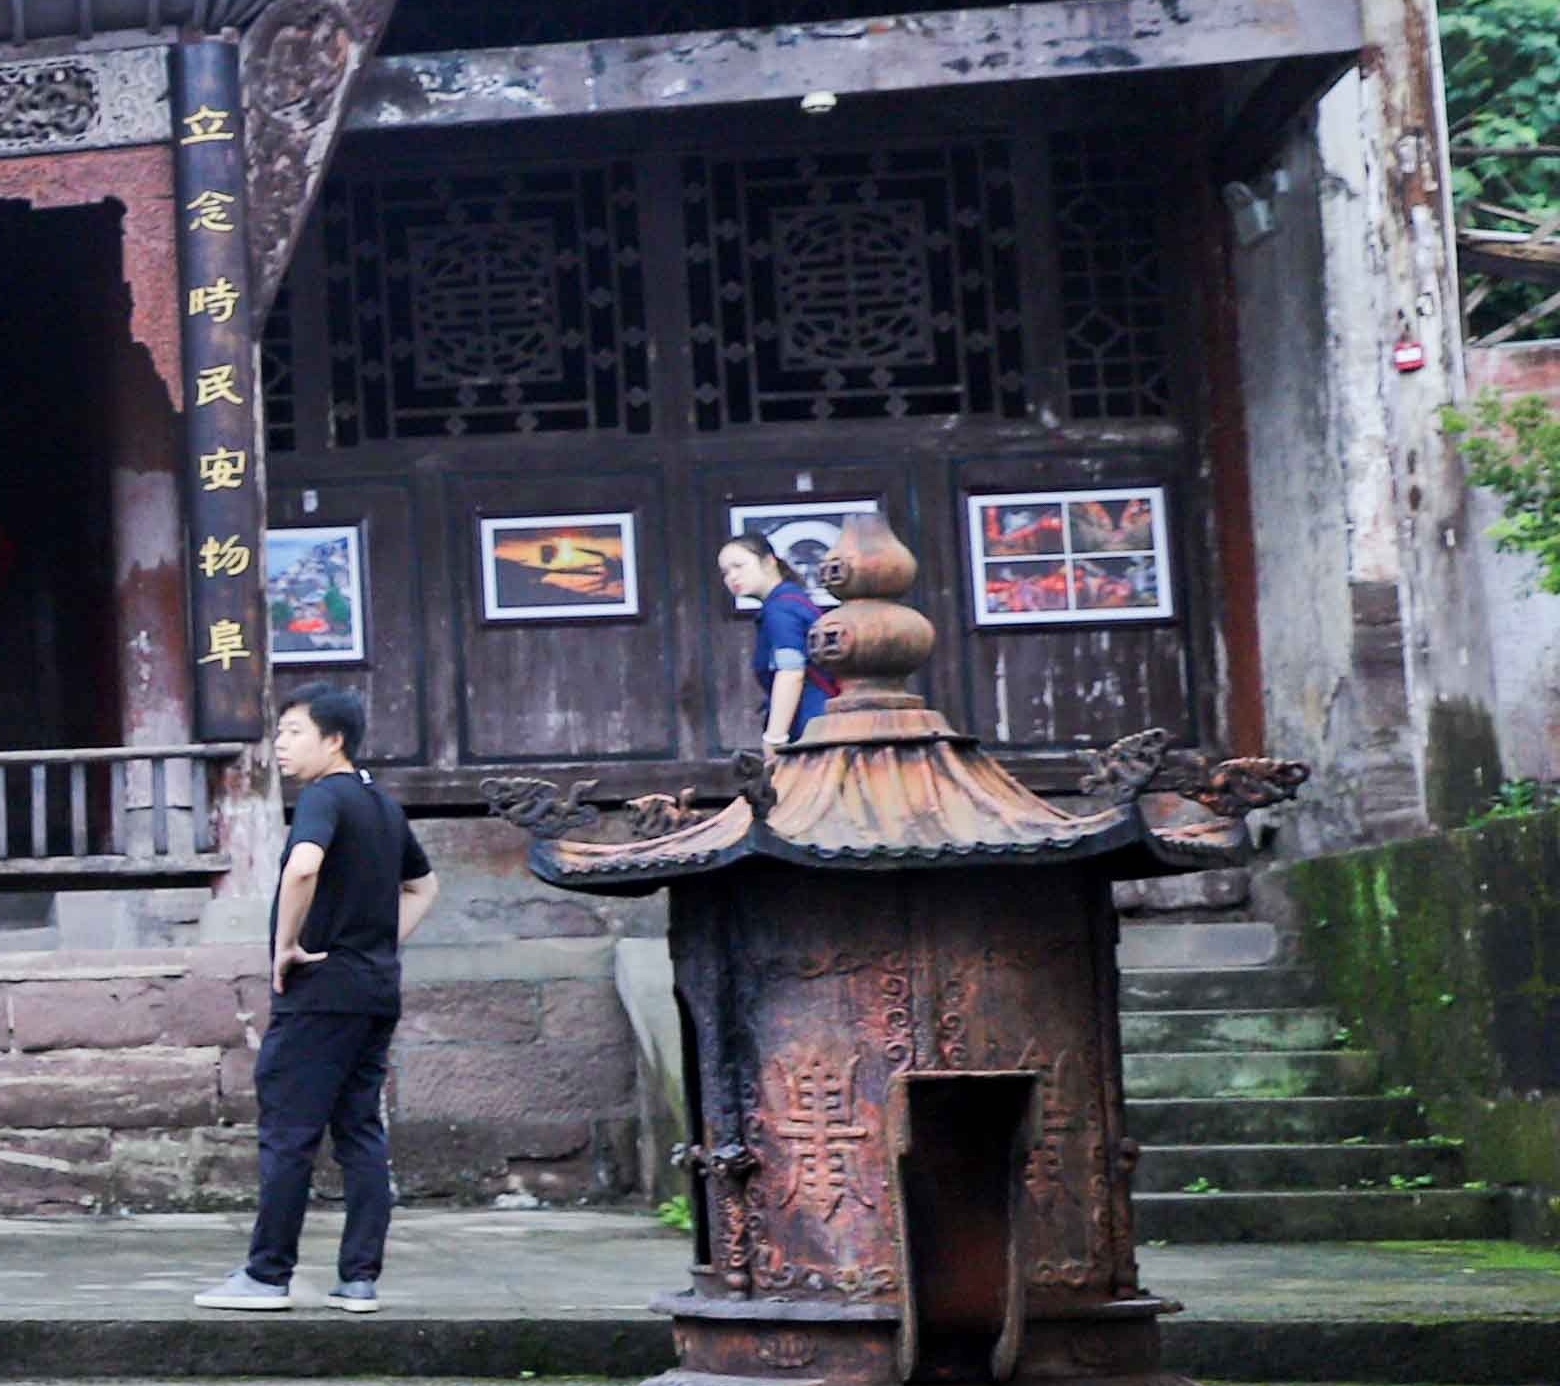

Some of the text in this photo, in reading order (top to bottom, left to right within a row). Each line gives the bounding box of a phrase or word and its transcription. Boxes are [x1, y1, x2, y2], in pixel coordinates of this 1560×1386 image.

[179, 105, 252, 671] 立念時民安物阜
